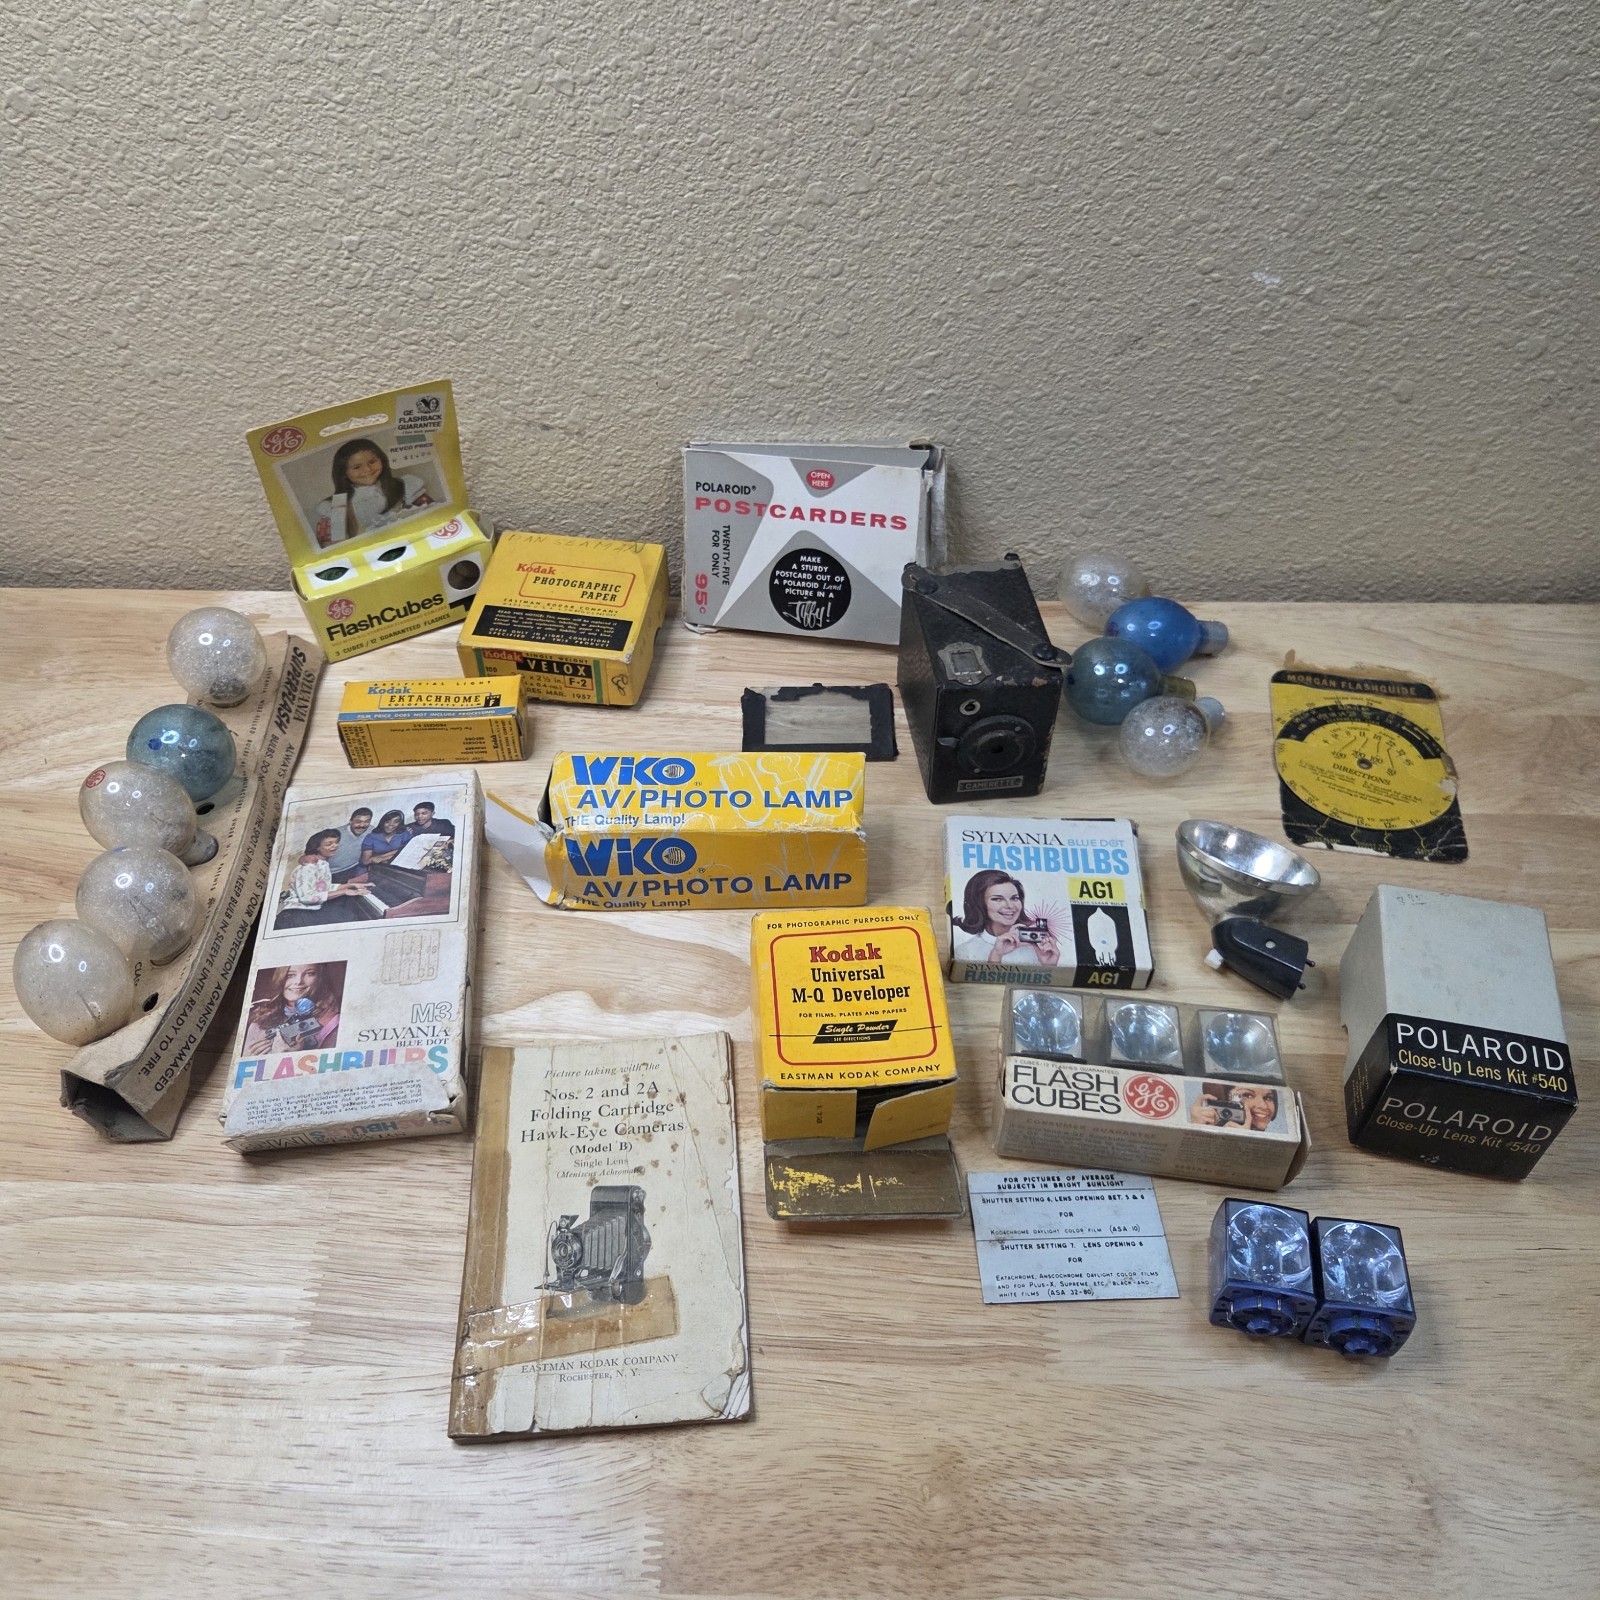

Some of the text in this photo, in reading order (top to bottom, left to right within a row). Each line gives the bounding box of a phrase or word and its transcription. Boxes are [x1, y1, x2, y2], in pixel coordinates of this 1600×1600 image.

[397, 421, 442, 430] GUARANTEE
[398, 414, 442, 424] FLASHBACK
[810, 471, 831, 480] OPEN
[811, 479, 830, 488] HERE
[695, 496, 908, 531] POSTCARDERS
[712, 529, 720, 578] FOR ONLY
[722, 524, 731, 586] TWENTY-FIVE
[800, 555, 821, 564] MAKE
[516, 563, 557, 575] Kodak
[775, 570, 813, 580] POSTCARD
[834, 575, 845, 583] OF
[801, 564, 829, 574] STURDY
[532, 576, 622, 593] PHOTOGRAPHIC
[783, 579, 843, 591] POLAROID Land
[785, 587, 826, 598] PICTURE IN
[580, 590, 618, 602] PAPER
[503, 598, 541, 606] EASTMAN
[579, 606, 620, 614] COMPANY
[326, 593, 444, 641] FlashCubes
[343, 613, 451, 654] CUBES GUARANTEED FLASHES
[483, 649, 523, 662] Kodak
[527, 660, 586, 676] VELOX
[273, 646, 308, 735] SUPERFLASH
[367, 687, 411, 695] Kodak
[568, 677, 588, 688] F-2
[1286, 674, 1418, 697] MORGAN FLASHGUIDE
[293, 670, 316, 723] SYLVANIA
[389, 695, 481, 704] EKTACHROME
[572, 693, 592, 701] 1957
[277, 742, 295, 779] ALWAYS
[1332, 762, 1391, 786] DIRECTIONS
[577, 789, 854, 809] AV/PHOTO LAMP
[565, 813, 686, 829] THE Quality Lamp!
[962, 830, 1125, 848] SYLVANIA BLUE DOT
[962, 843, 1130, 876] FLASHBULBS
[582, 873, 853, 898] AV/PHOTO LAMP
[1078, 880, 1114, 899] AG1
[245, 891, 261, 918] YOUR
[603, 898, 691, 909] Quality Lamp!
[786, 918, 850, 928] PHOTOGRAPHIC
[853, 915, 894, 924] PURPOSES
[898, 914, 920, 922] ONLY
[223, 920, 253, 981] PROTECTION
[809, 943, 882, 963] Kodak
[811, 965, 885, 983] Universal
[964, 968, 1052, 985] FLASHBULBS
[966, 963, 1020, 973] SYLVANIA
[1087, 971, 1120, 985] AG1
[792, 984, 911, 1004] M-Q Developer
[137, 932, 224, 1077] SLEEVE UNTIL READY FIRE.
[196, 981, 223, 1034] AGAINST
[411, 1001, 452, 1023] M3
[882, 1007, 907, 1015] PAPERS
[357, 1026, 450, 1044] SYLVANIA
[824, 1022, 890, 1035] Single Powder
[395, 1037, 449, 1047] BLUE DOT
[1396, 1022, 1564, 1071] POLAROID
[154, 1033, 197, 1092] DAMAGED
[544, 1062, 660, 1079] Picture taking with the
[1079, 1066, 1120, 1075] GUARANTEED
[1398, 1049, 1568, 1093] Close-Up Lens Kit #540
[781, 1063, 941, 1081] EASTMAN KODAK COMPANY
[1013, 1065, 1119, 1094] FLASH
[544, 1081, 659, 1102] Nos. 2 and 2A
[1011, 1084, 1122, 1115] CUBES
[397, 1098, 422, 1106] CAUTION
[530, 1100, 675, 1122] Folding Cartridge
[1381, 1097, 1552, 1142] POLAROID
[521, 1121, 685, 1143] Hawk-Eye Cameras
[1375, 1114, 1503, 1148] Close-Up Lens Kit
[569, 1142, 633, 1155] (Model B)
[573, 1157, 629, 1169] Single Lens
[556, 1170, 597, 1179] (Meniscus
[1109, 1224, 1128, 1234] (ASA
[1047, 1288, 1066, 1298] (ASA
[521, 1354, 679, 1373] EASTMAN KODAK COMPANY
